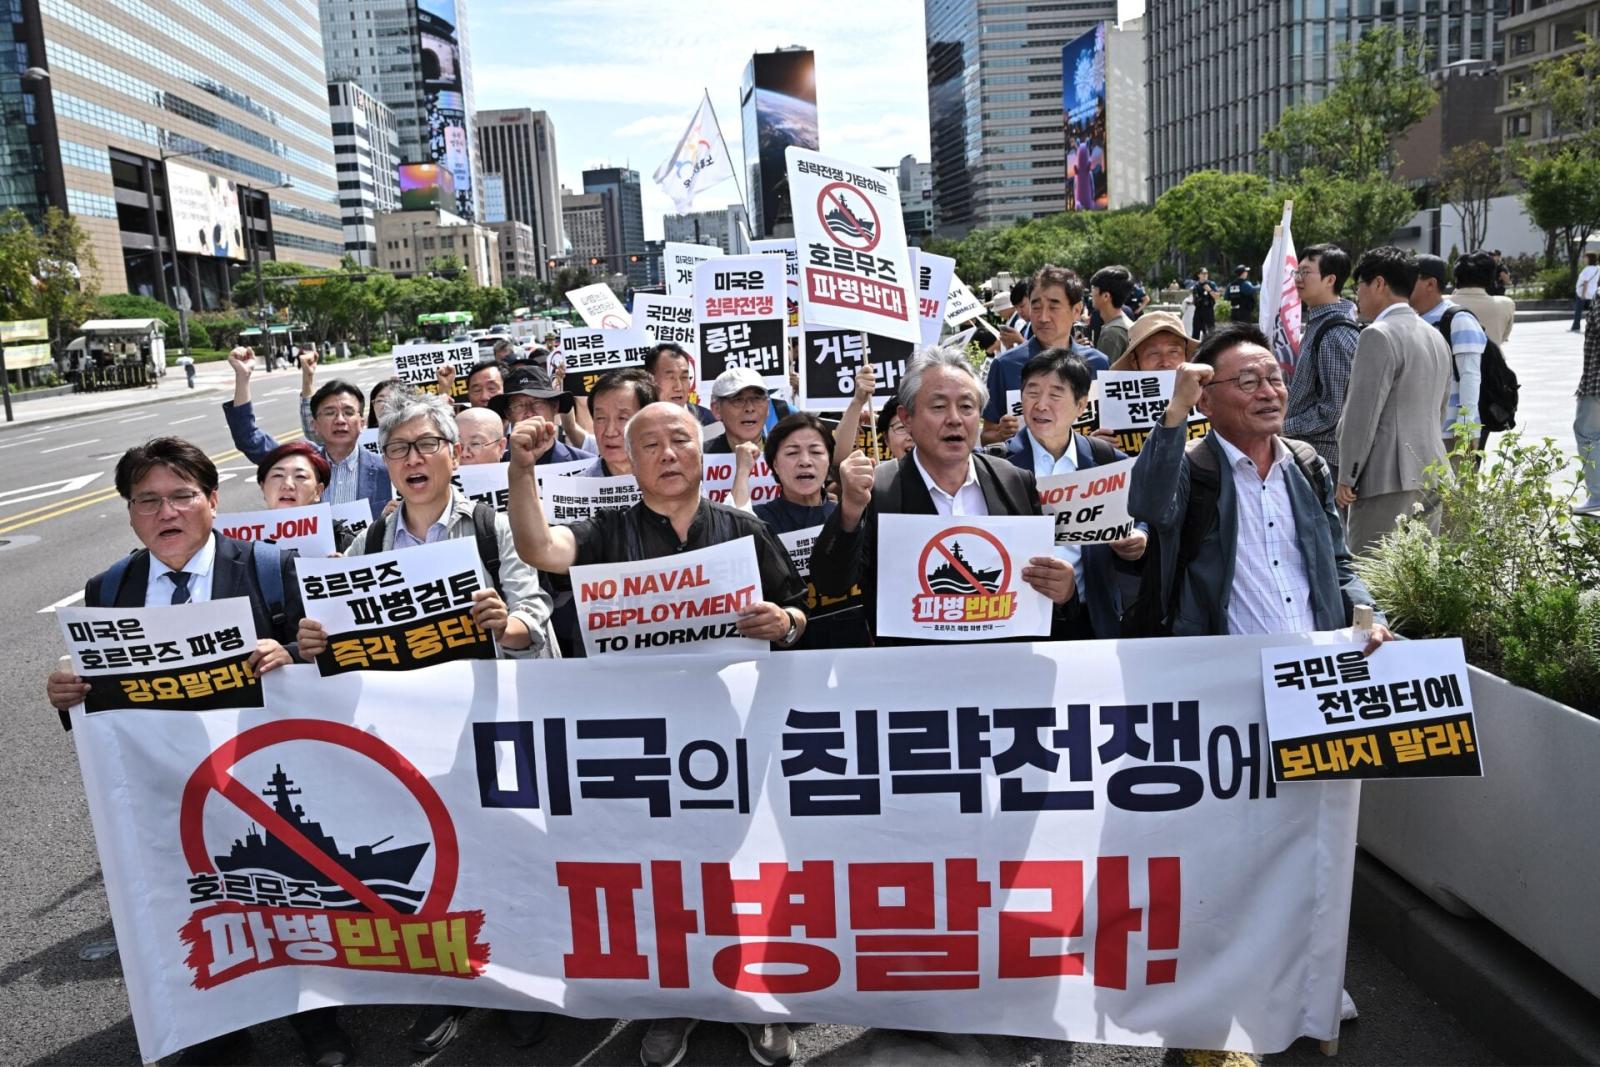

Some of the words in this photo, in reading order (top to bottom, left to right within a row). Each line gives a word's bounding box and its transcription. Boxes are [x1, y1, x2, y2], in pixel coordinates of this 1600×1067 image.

[797, 160, 843, 181] 침략전쟁
[845, 171, 887, 195] 가담하는
[808, 243, 898, 283] 호르무즈
[714, 271, 764, 291] 미국은
[813, 273, 903, 314] 파병반대
[705, 296, 774, 317] 침략전쟁
[564, 335, 605, 351] 미국은
[705, 323, 752, 353] 중단
[813, 335, 872, 365] 거부
[395, 350, 445, 369] 침략전쟁
[447, 346, 473, 361] 지원
[565, 350, 621, 369] 호르무즈
[724, 345, 780, 371] 하라!
[1105, 376, 1161, 400] 국민을
[706, 464, 732, 481] NO
[1080, 471, 1126, 499] JOIN
[269, 516, 318, 540] JOIN
[554, 505, 590, 519] 침략적
[1076, 504, 1105, 523] OF
[302, 560, 405, 601] 호르무즈
[581, 579, 617, 603] NO
[623, 564, 711, 597] NAVAL
[347, 569, 481, 625] 파병검토
[588, 584, 756, 631] DEPLOYMENT
[917, 594, 1013, 621] 파병반대
[67, 617, 145, 643] 미국은
[331, 634, 400, 667] 즉각
[405, 614, 488, 660] 중단!
[595, 636, 629, 654] TO
[634, 622, 747, 649] HORMUZ
[78, 640, 185, 670] 호르무즈
[186, 626, 245, 657] 파병
[120, 660, 256, 703] 강요말라!
[1273, 650, 1371, 691] 국민을
[1317, 674, 1464, 725] 전쟁터에
[472, 717, 750, 818] 미국의
[781, 700, 1277, 817] 침략전쟁에
[1279, 734, 1383, 779] 보내지
[1389, 720, 1475, 764] 말라!
[187, 874, 322, 907] 호르무즈
[555, 856, 1181, 994] 파병말라!
[201, 911, 471, 977] 파병반대
